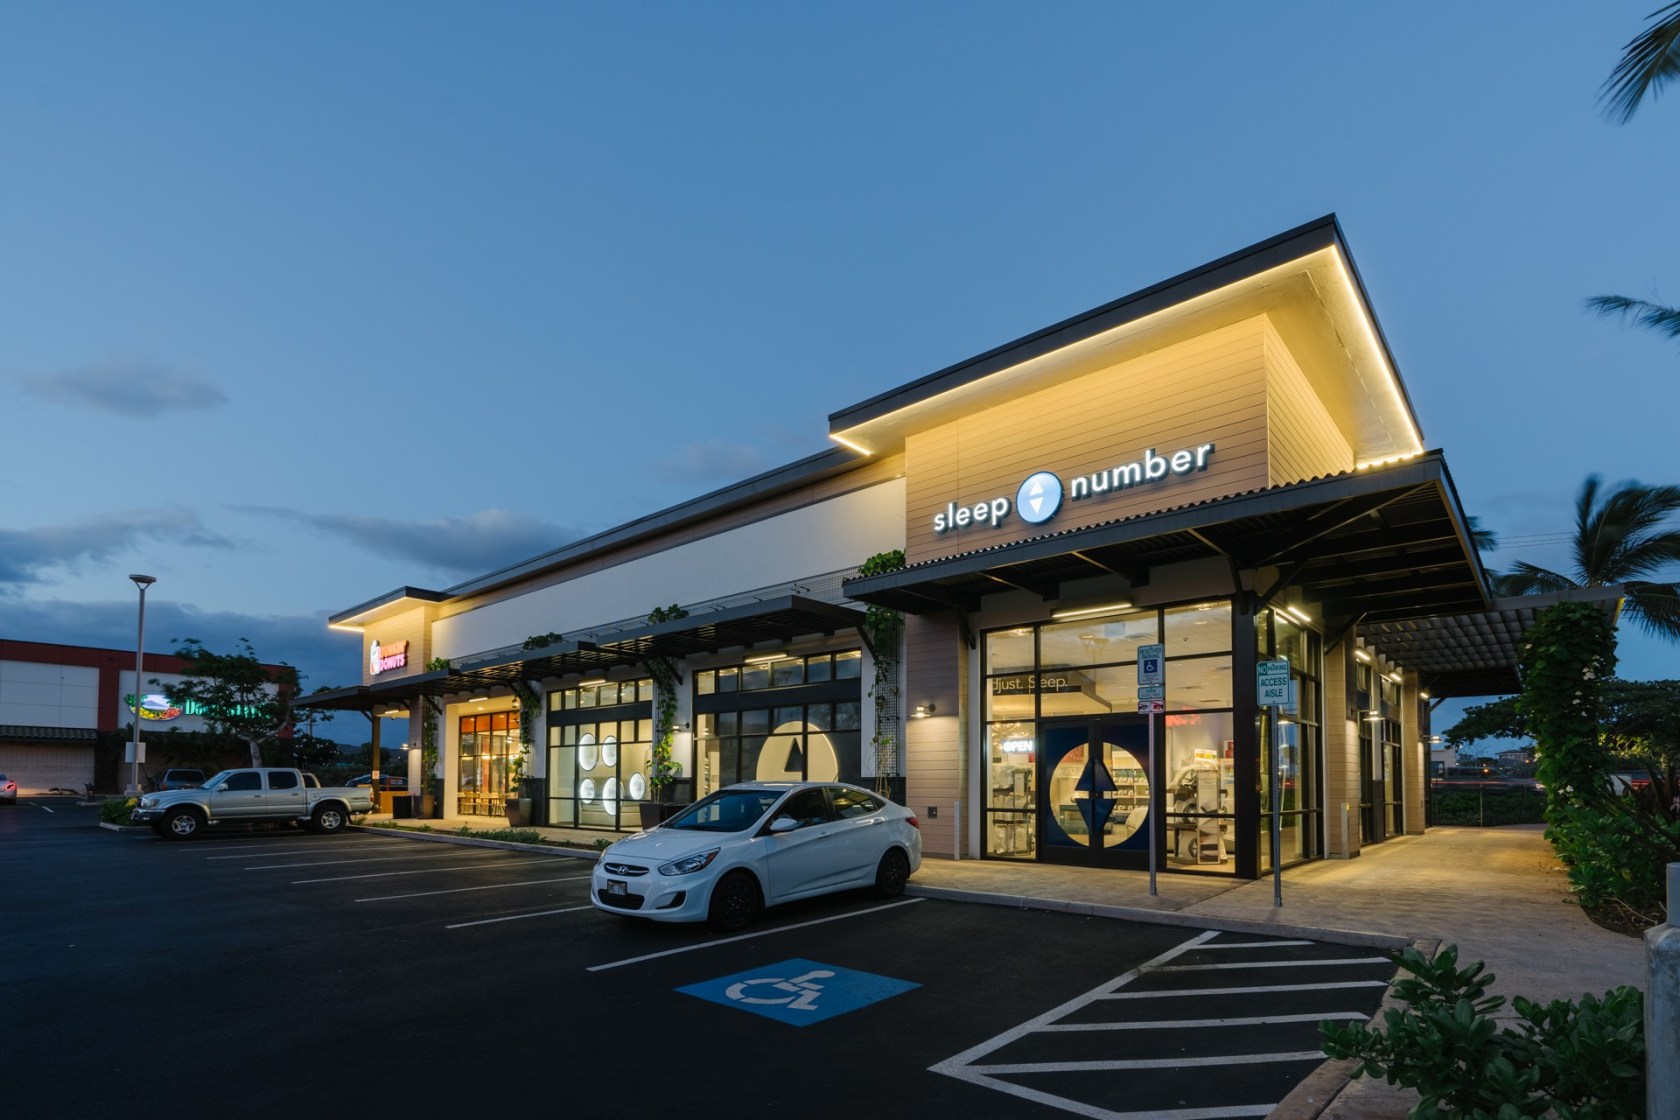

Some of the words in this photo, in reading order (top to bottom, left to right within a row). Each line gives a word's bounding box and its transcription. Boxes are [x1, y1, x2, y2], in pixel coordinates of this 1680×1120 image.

[933, 496, 1011, 533] sleep
[1071, 443, 1215, 501] number
[380, 654, 406, 672] DONUTS
[1258, 663, 1268, 675] NO
[992, 677, 1024, 694] djust.
[1028, 675, 1068, 692] Seep.
[1260, 677, 1287, 687] ACCESS
[1264, 688, 1283, 698] AISLE
[1003, 741, 1034, 753] OPEN
